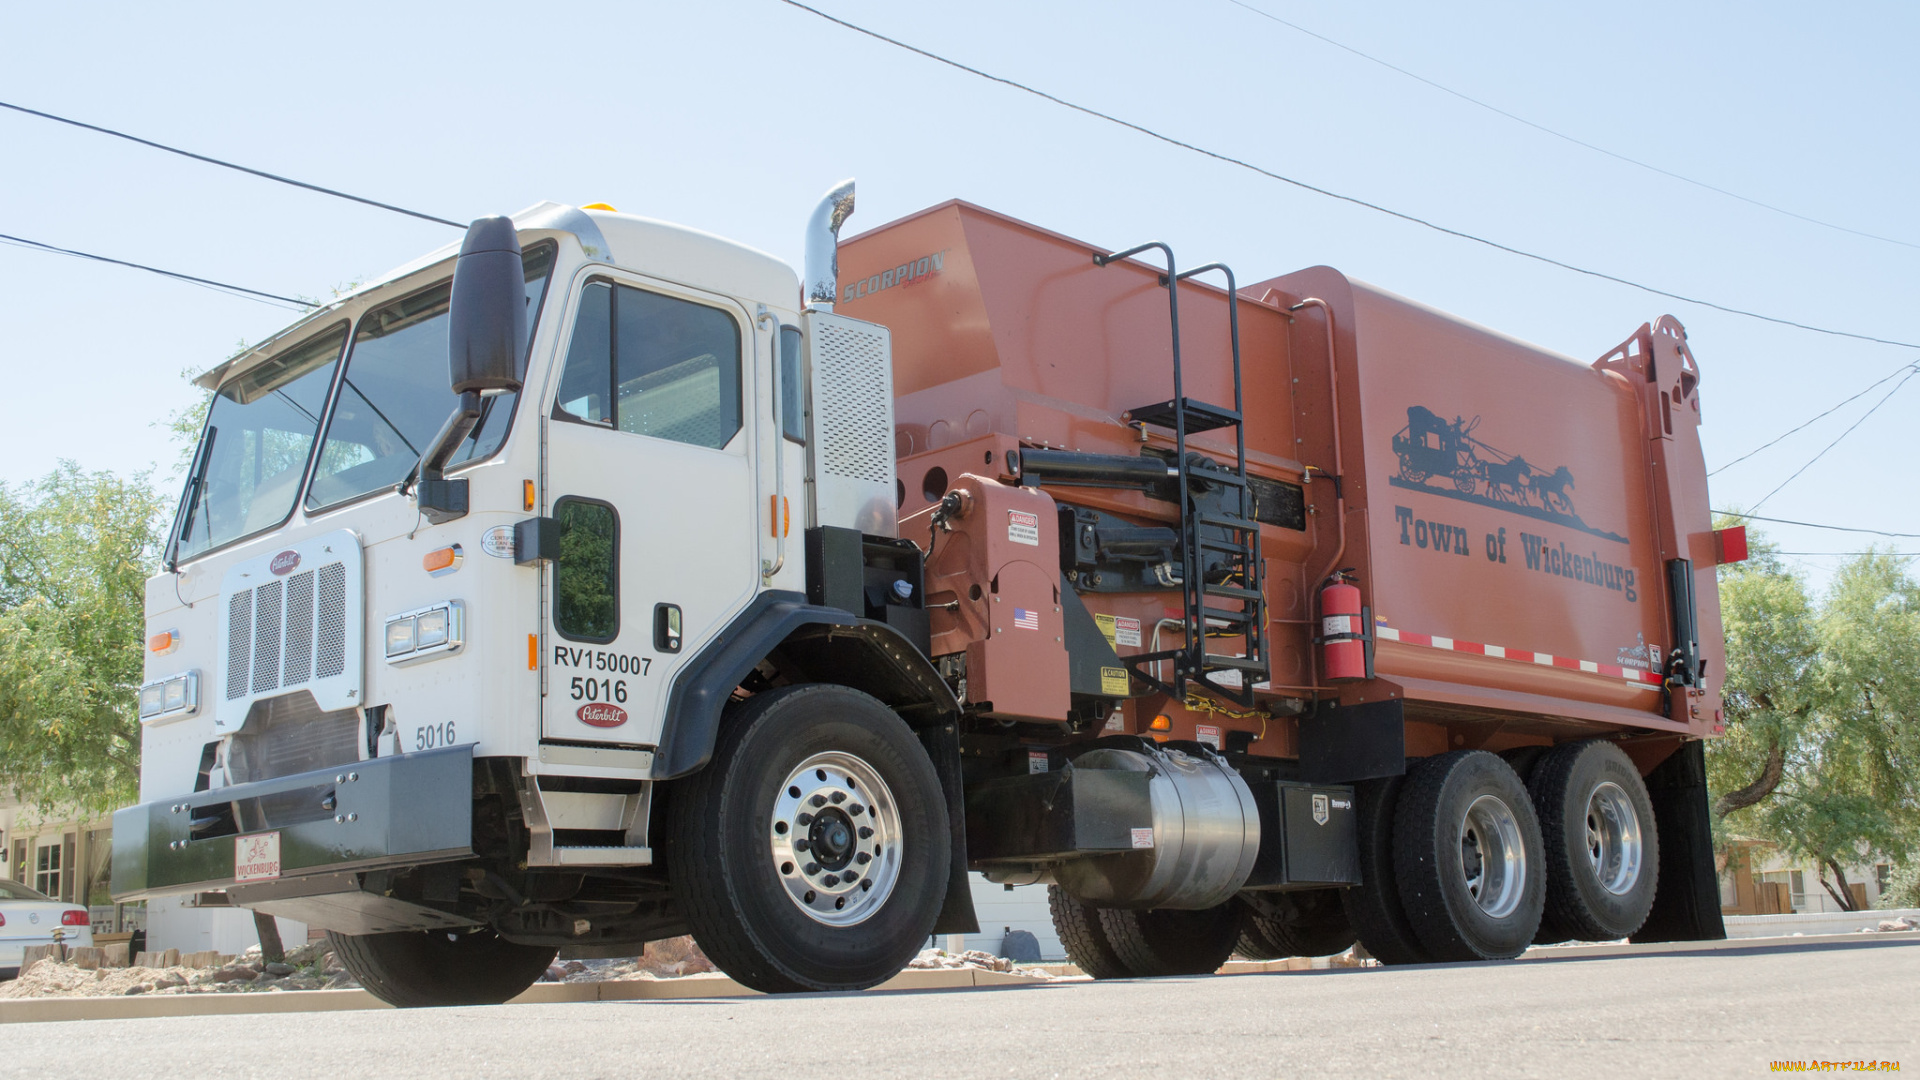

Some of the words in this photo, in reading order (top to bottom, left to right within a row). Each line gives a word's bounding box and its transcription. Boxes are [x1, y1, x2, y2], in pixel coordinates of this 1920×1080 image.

[843, 250, 945, 304] SCORPION
[1395, 505, 1469, 556] Town
[1486, 527, 1507, 564] of
[1520, 532, 1637, 602] Wickenburg
[554, 645, 652, 676] RV150007
[1616, 656, 1649, 669] SCORPION
[570, 677, 628, 703] 5016
[582, 706, 625, 722] Peterbilt
[416, 720, 456, 750] 5016
[237, 861, 278, 876] WICKENBURG
